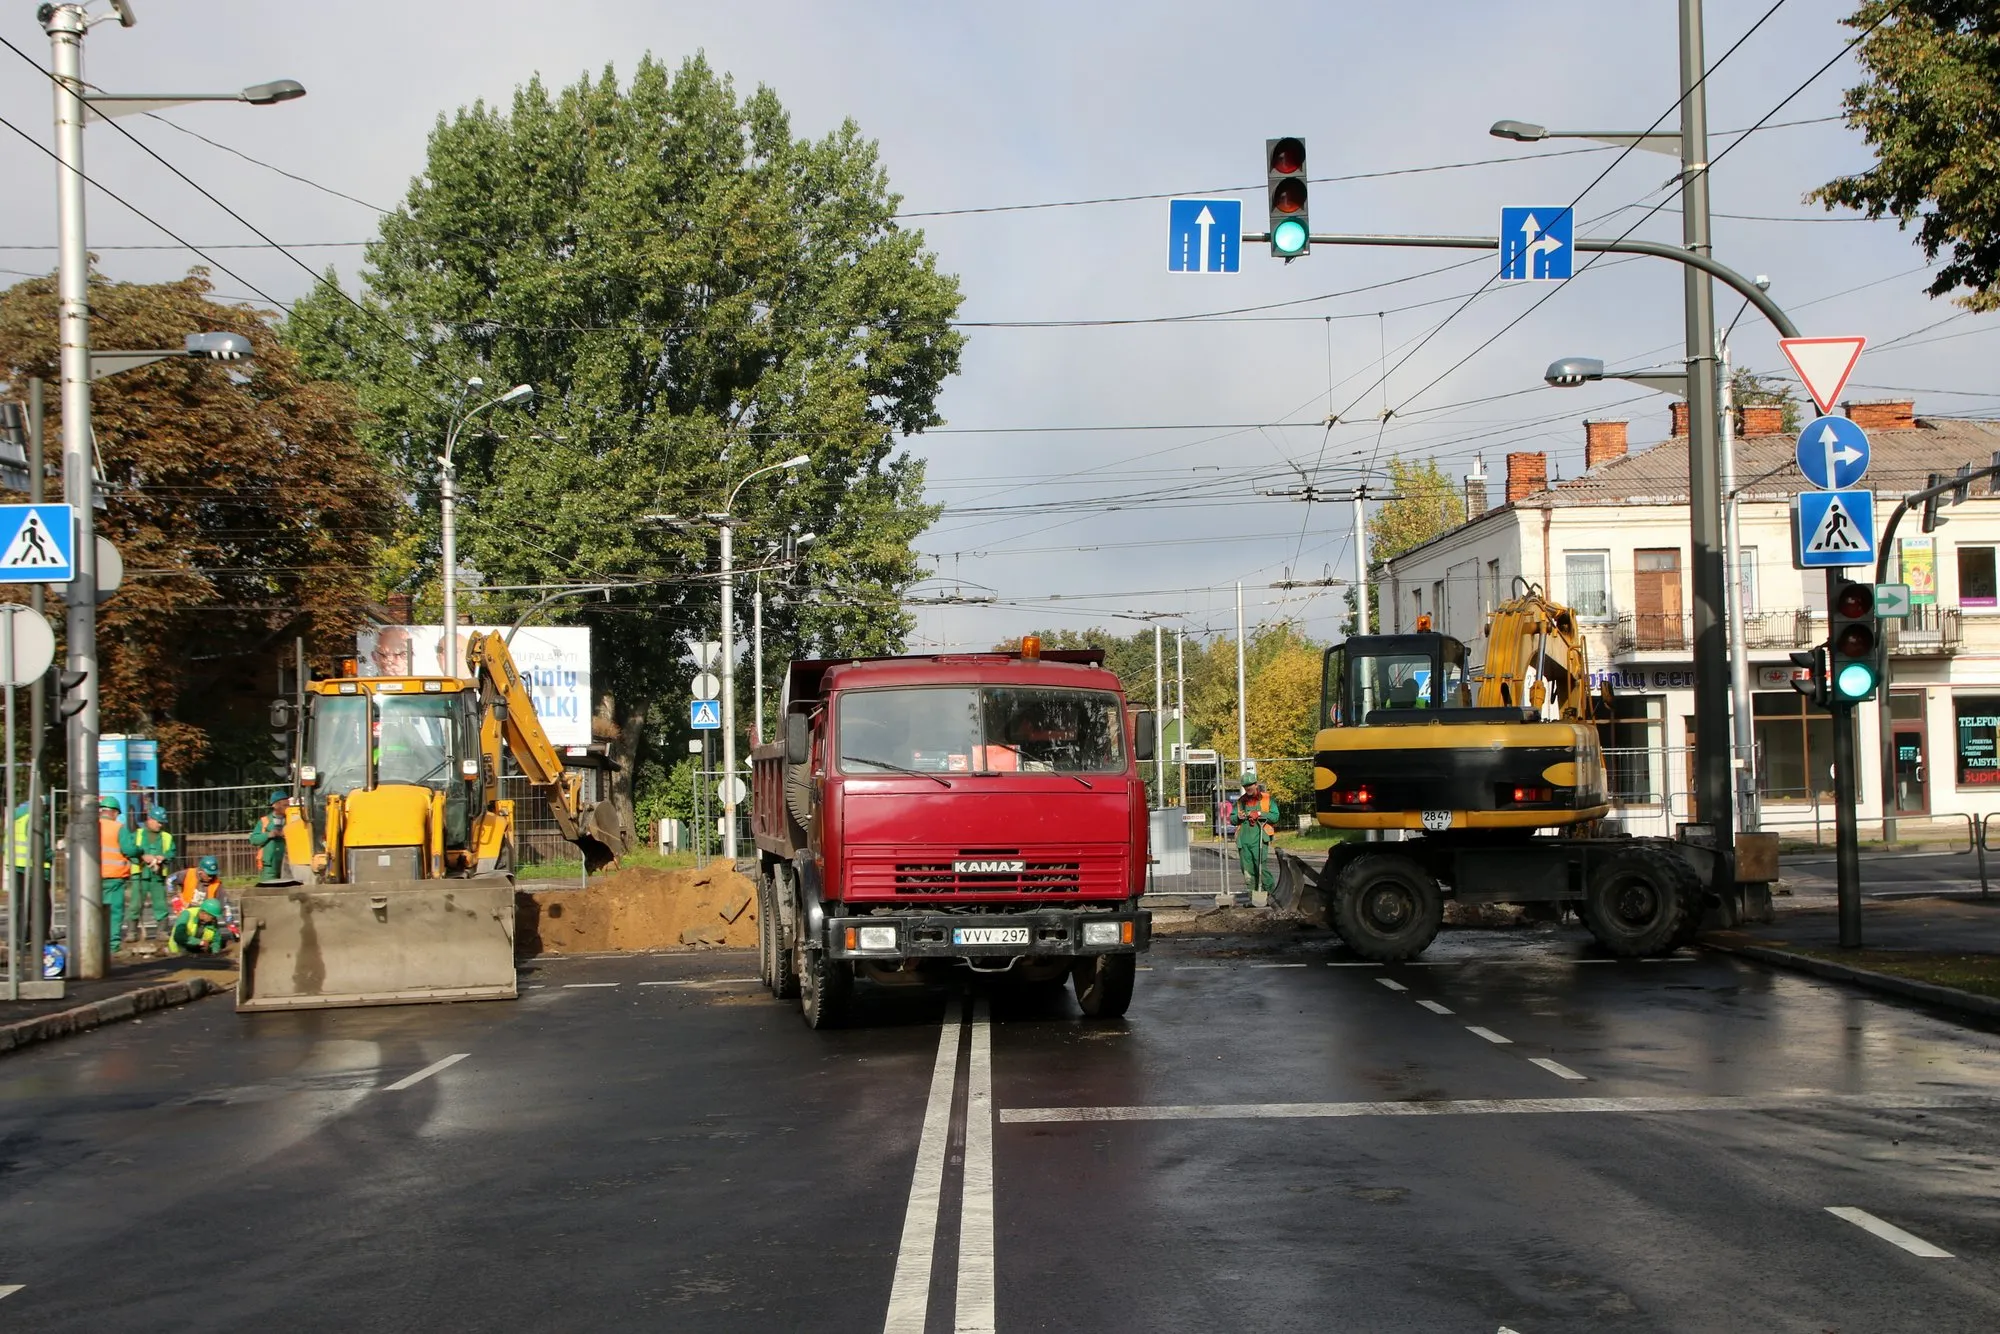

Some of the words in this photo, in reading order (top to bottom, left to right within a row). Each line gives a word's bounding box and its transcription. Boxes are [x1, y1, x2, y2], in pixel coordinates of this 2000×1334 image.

[1424, 811, 1449, 821] 2847
[954, 861, 1024, 873] KAMAZ
[963, 930, 992, 942] VVV
[1002, 929, 1027, 942] 297
